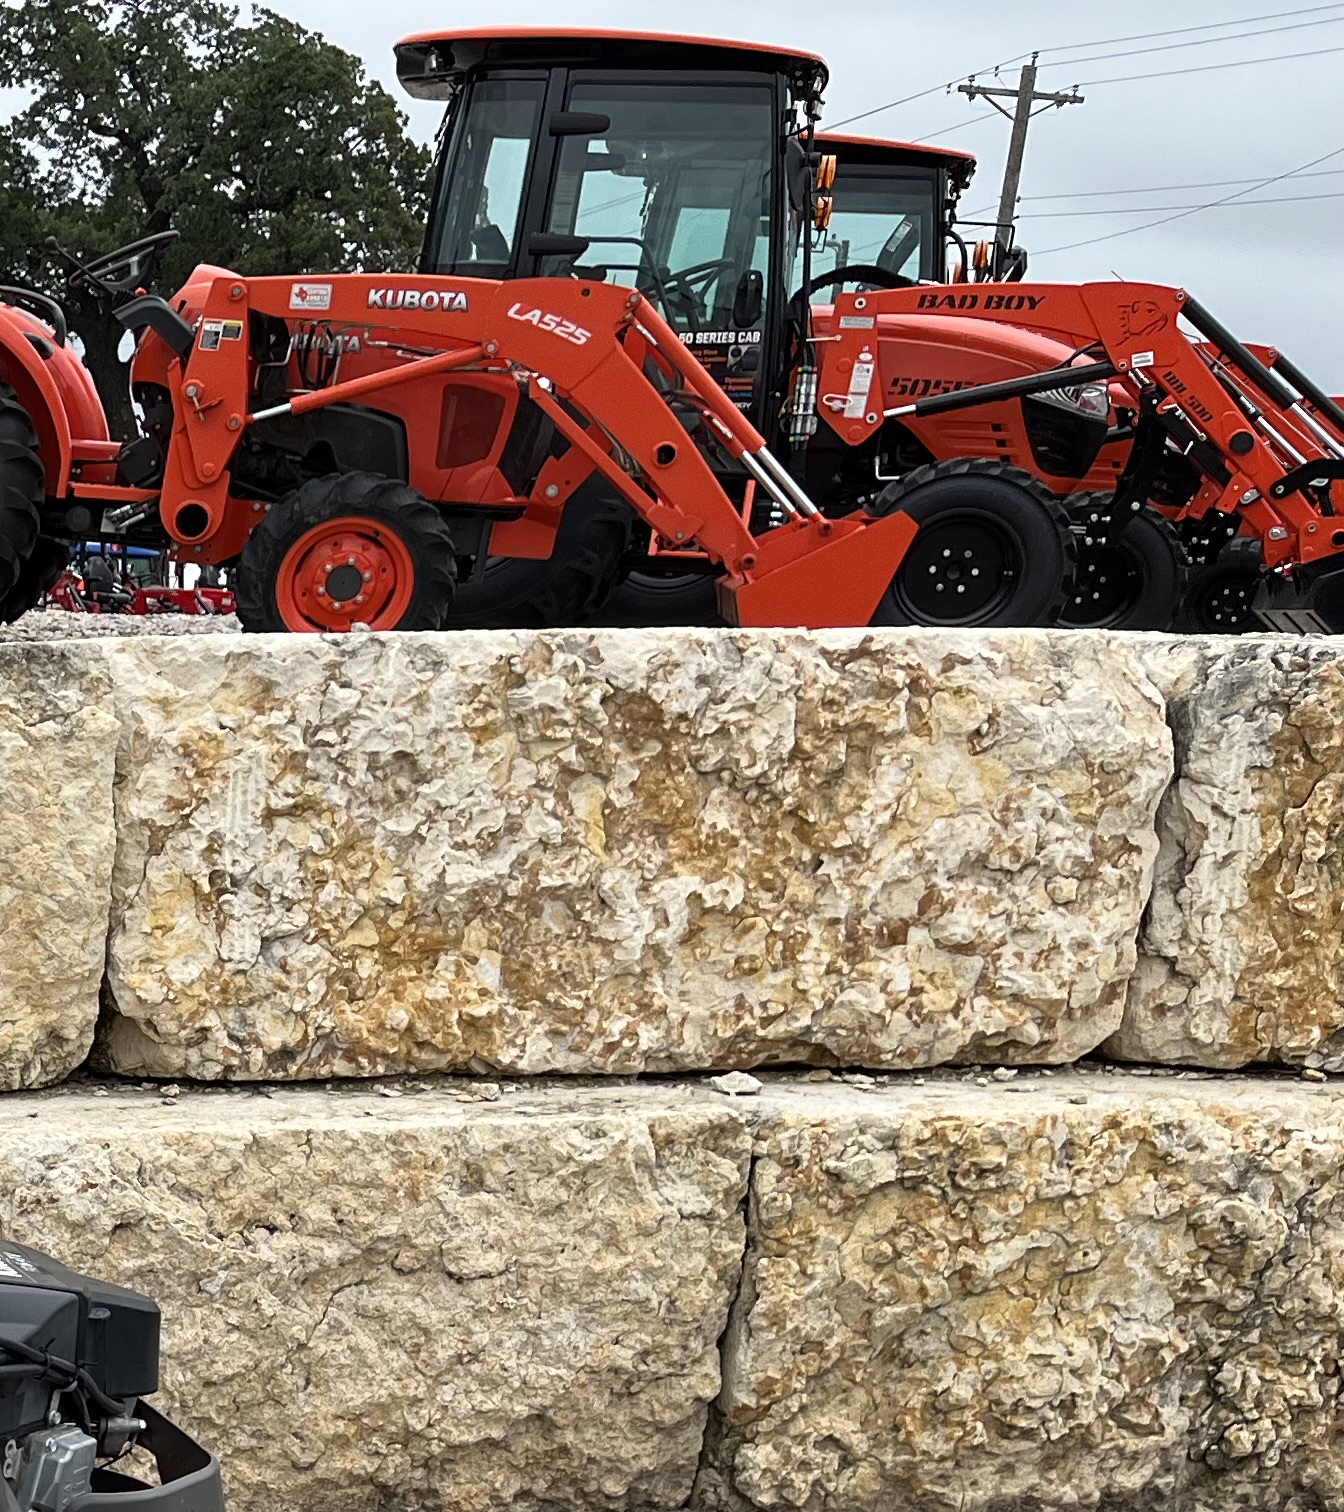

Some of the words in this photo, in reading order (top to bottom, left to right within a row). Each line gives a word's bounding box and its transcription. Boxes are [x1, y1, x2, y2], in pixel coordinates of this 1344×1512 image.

[367, 288, 469, 312] KUBOTA
[917, 294, 980, 309] BAD
[983, 295, 1047, 310] BOY
[506, 302, 592, 346] LA525
[695, 331, 736, 344] SERIES
[737, 331, 761, 343] CAB
[1187, 395, 1214, 423] 500
